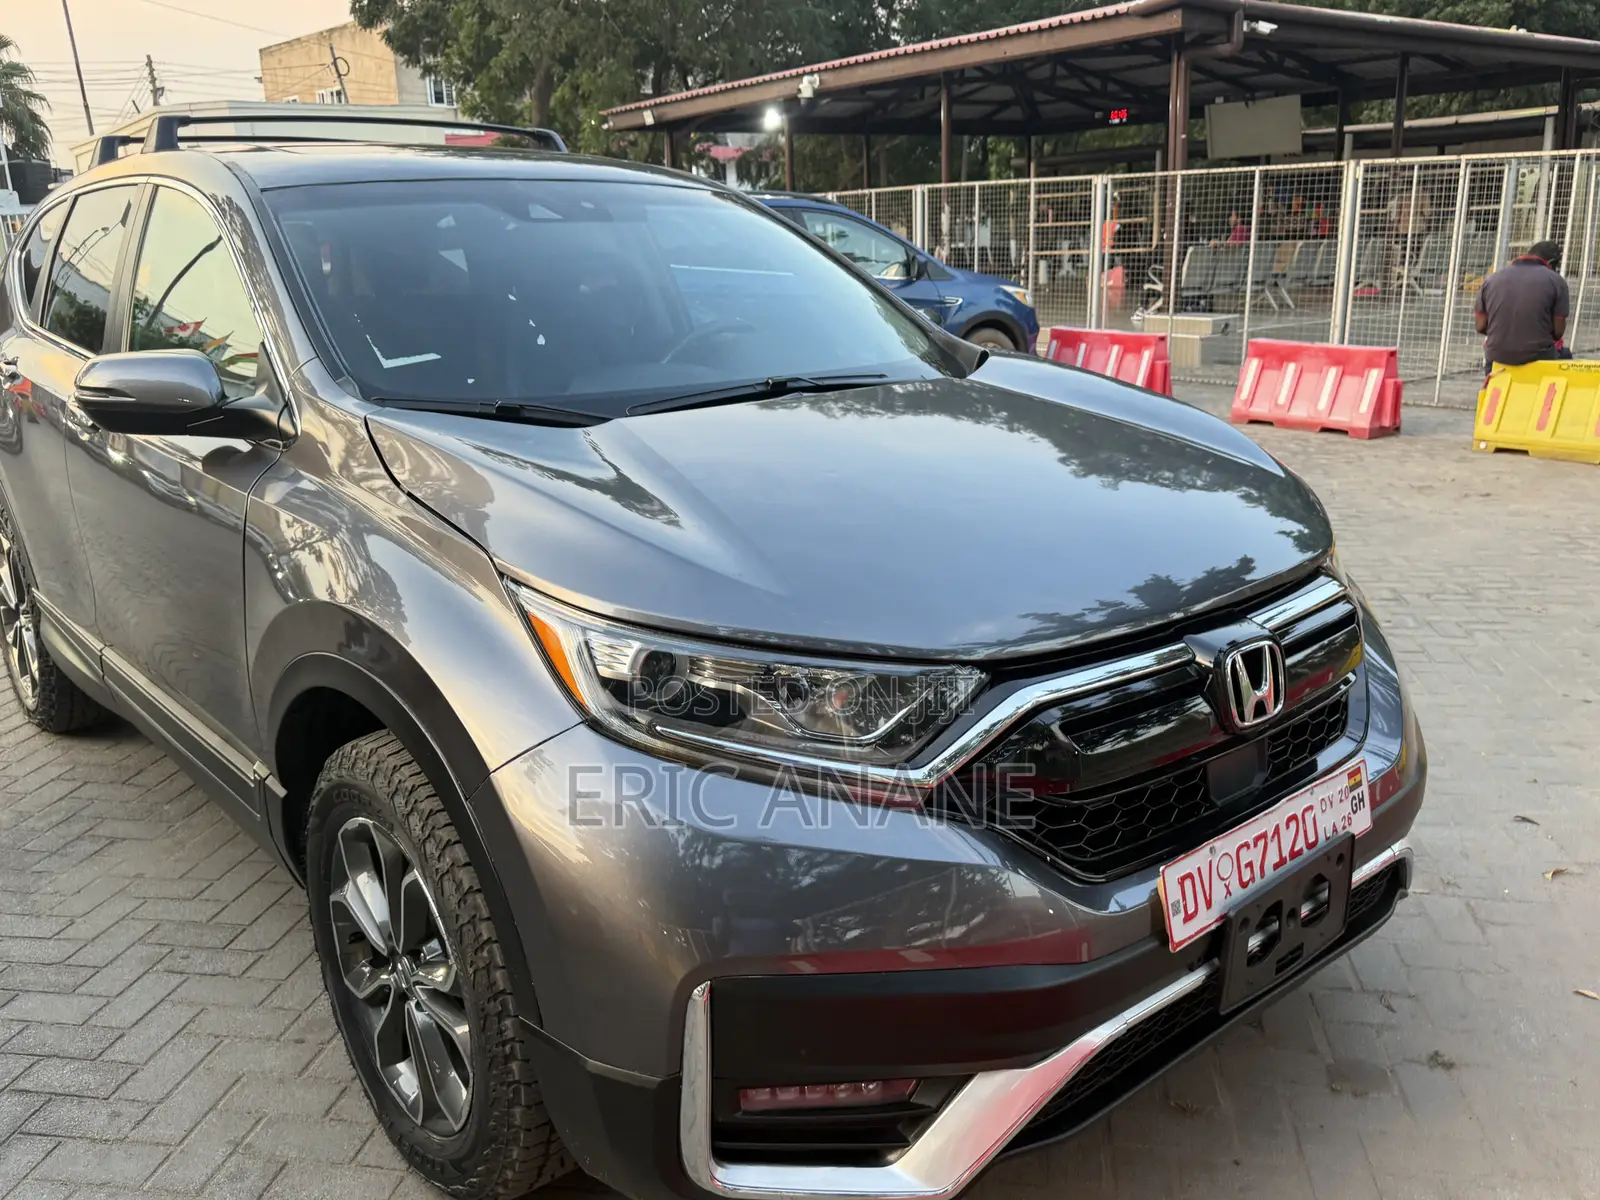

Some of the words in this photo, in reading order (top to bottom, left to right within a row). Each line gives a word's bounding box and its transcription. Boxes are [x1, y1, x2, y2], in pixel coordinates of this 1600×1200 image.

[1320, 793, 1334, 813] DV
[1338, 785, 1350, 803] 20
[1350, 790, 1365, 815] GH
[1323, 821, 1339, 841] LA
[1177, 859, 1213, 925] DV
[1235, 804, 1319, 889] G7120
